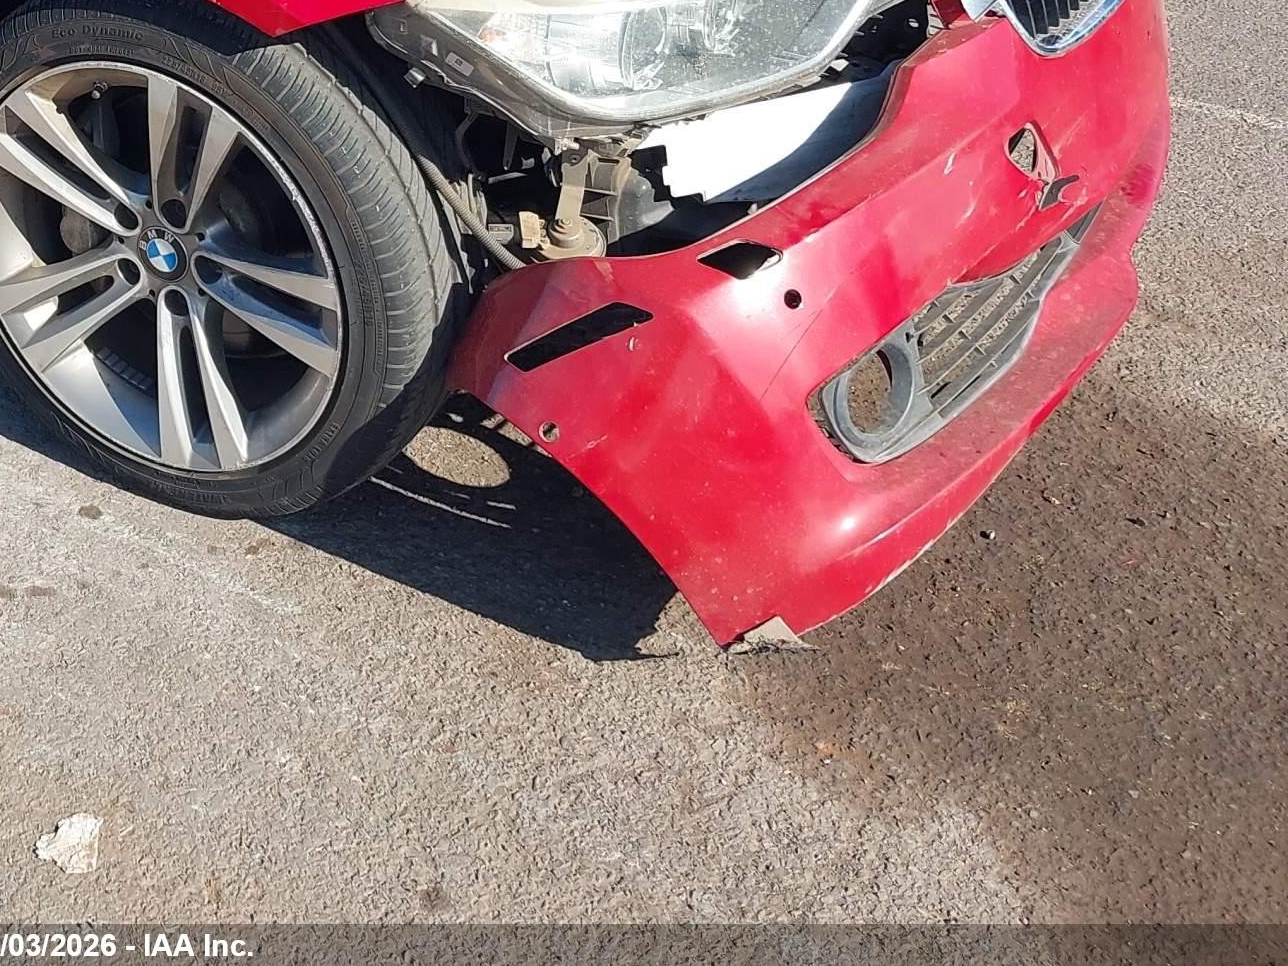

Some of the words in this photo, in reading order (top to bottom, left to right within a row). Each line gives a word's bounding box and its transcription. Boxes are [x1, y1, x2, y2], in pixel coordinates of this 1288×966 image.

[51, 27, 76, 39] Eco
[82, 24, 144, 41] Dynamic
[139, 229, 174, 251] BMW
